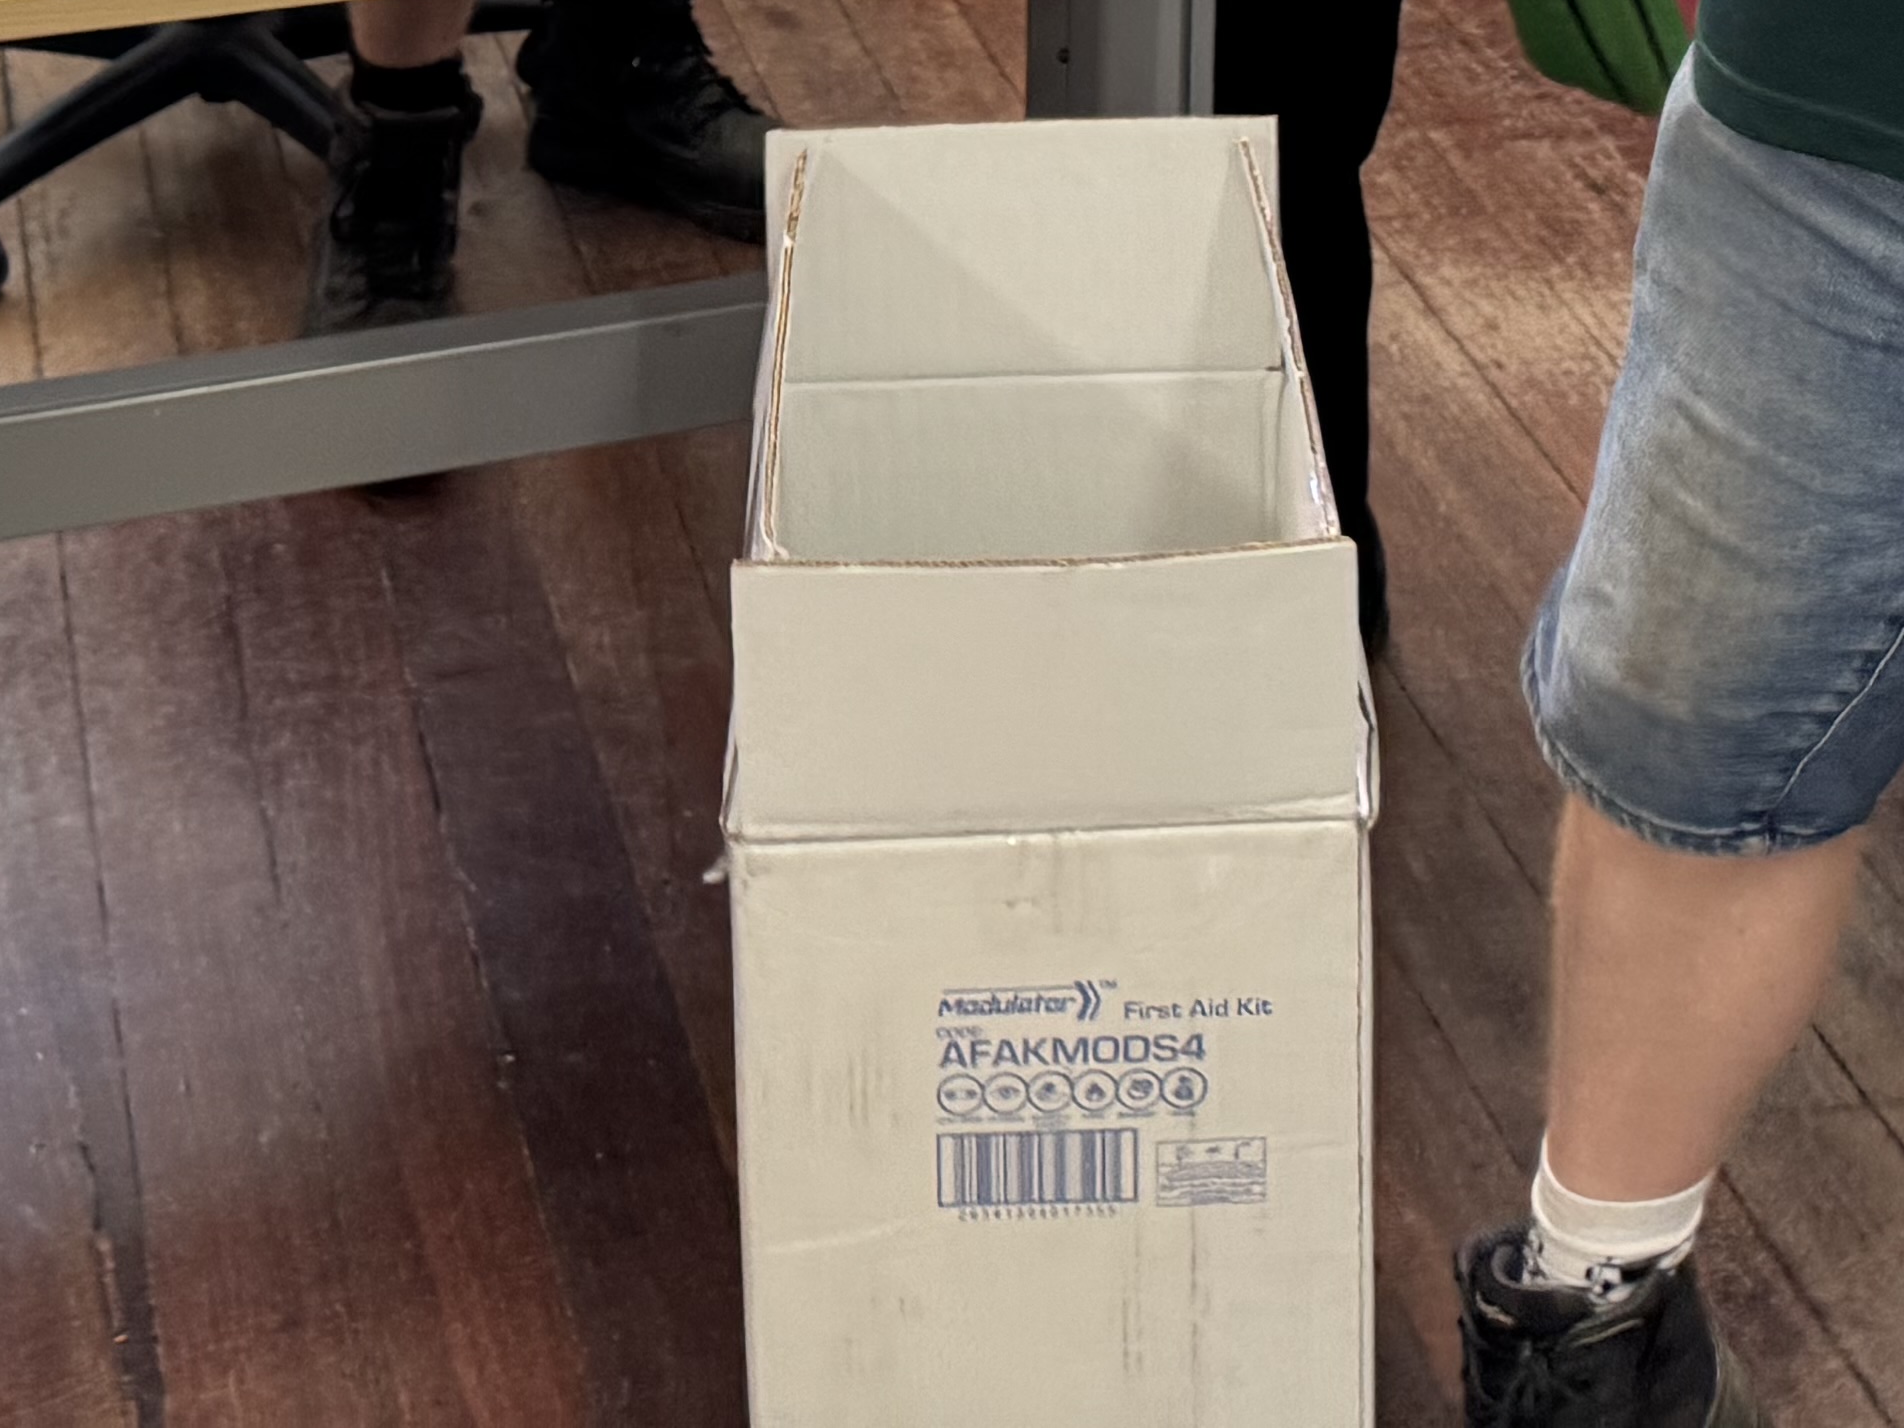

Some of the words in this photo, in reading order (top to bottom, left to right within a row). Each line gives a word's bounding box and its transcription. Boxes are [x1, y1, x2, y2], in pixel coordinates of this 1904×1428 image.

[937, 991, 1077, 1019] Modulator
[1123, 1000, 1182, 1020] First
[1189, 998, 1230, 1019] Aid
[1236, 996, 1273, 1017] Kit
[938, 1032, 1208, 1069] AFAKMODS4
